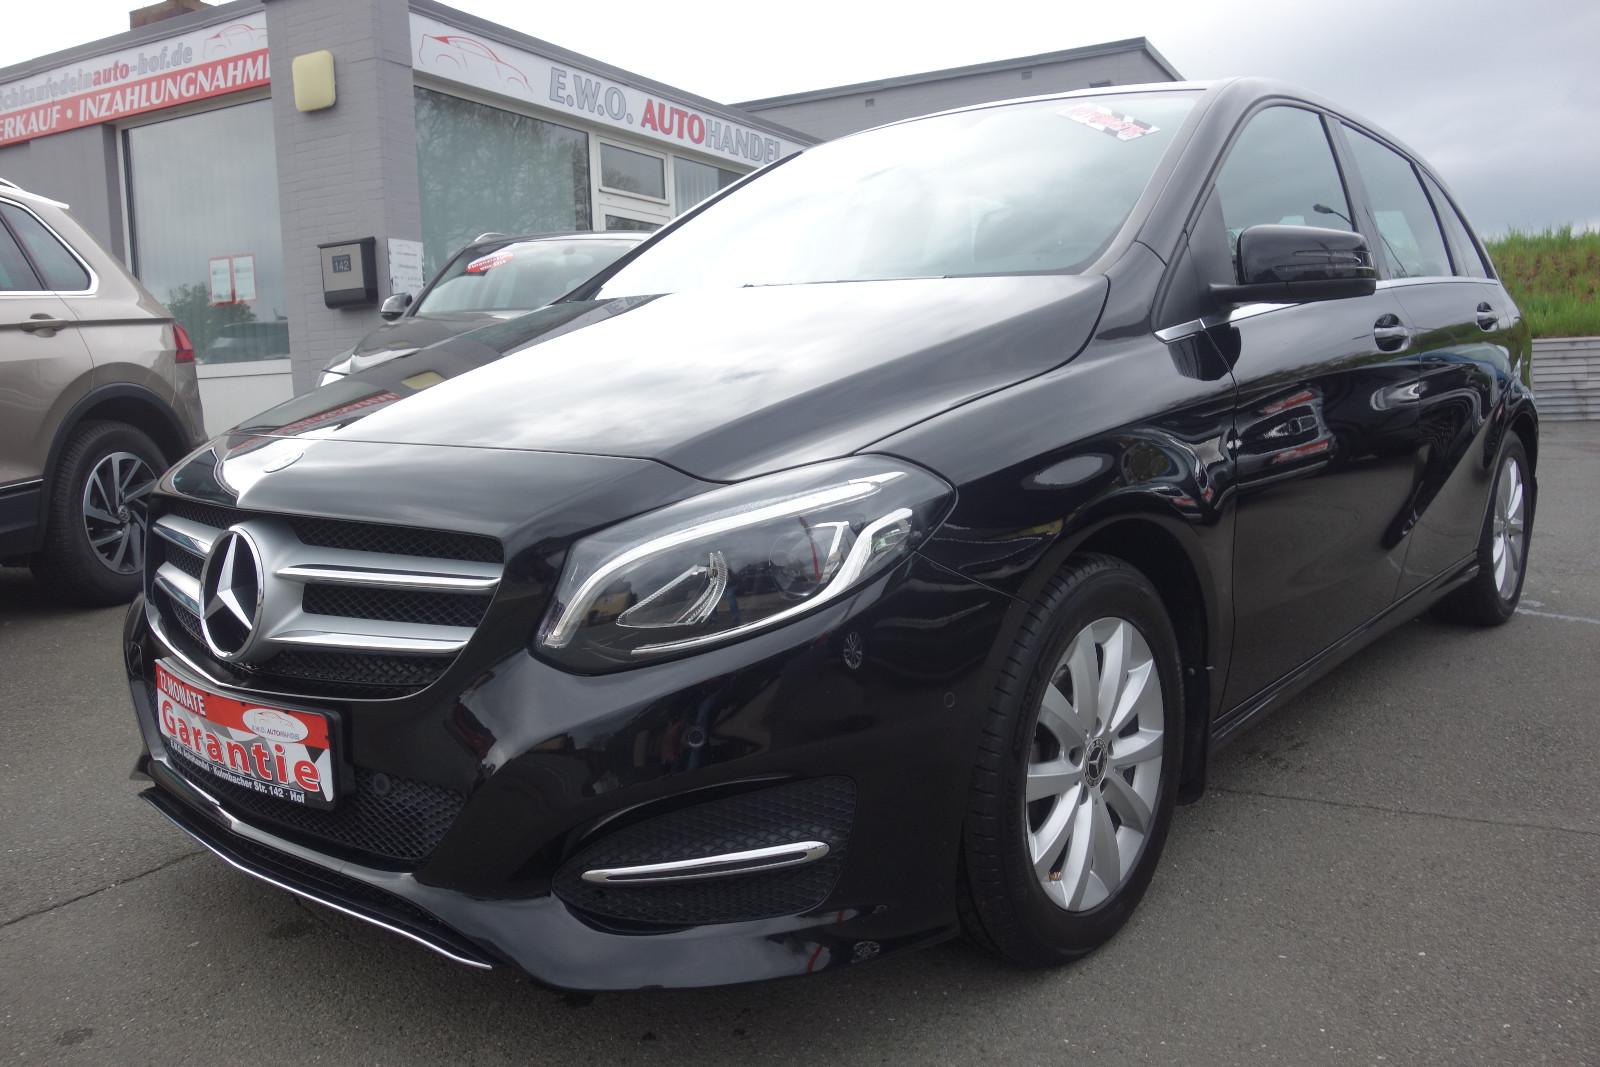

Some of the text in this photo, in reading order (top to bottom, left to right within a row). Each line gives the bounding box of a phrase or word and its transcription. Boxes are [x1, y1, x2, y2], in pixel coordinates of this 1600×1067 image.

[549, 66, 634, 125] E.W.O.
[159, 671, 206, 717] 12 MONATE
[161, 697, 320, 793] Garantie
[253, 781, 268, 794] Str.
[269, 786, 284, 798] 142
[290, 790, 305, 804] Hof
